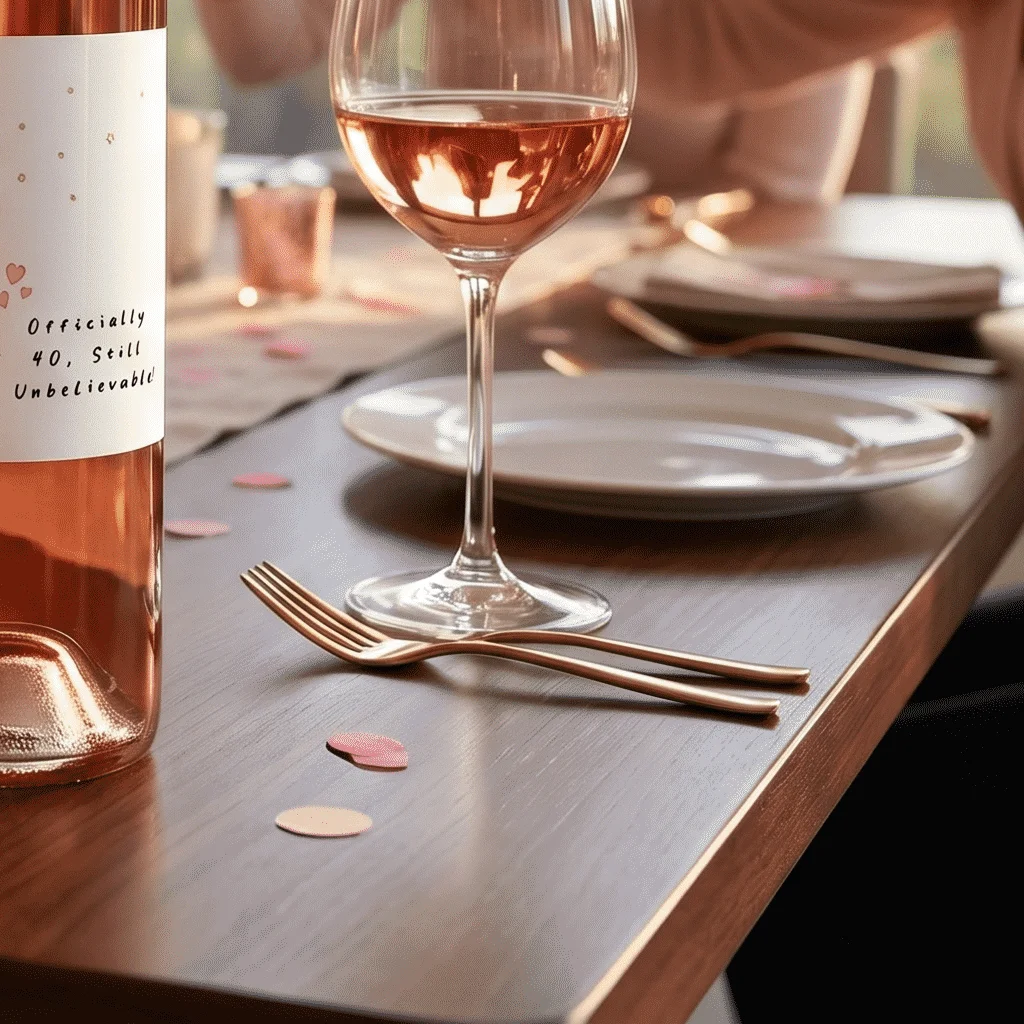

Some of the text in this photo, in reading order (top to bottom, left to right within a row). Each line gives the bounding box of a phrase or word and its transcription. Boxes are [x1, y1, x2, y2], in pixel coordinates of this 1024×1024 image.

[27, 308, 145, 335] Officially
[32, 340, 140, 368] 40, Still
